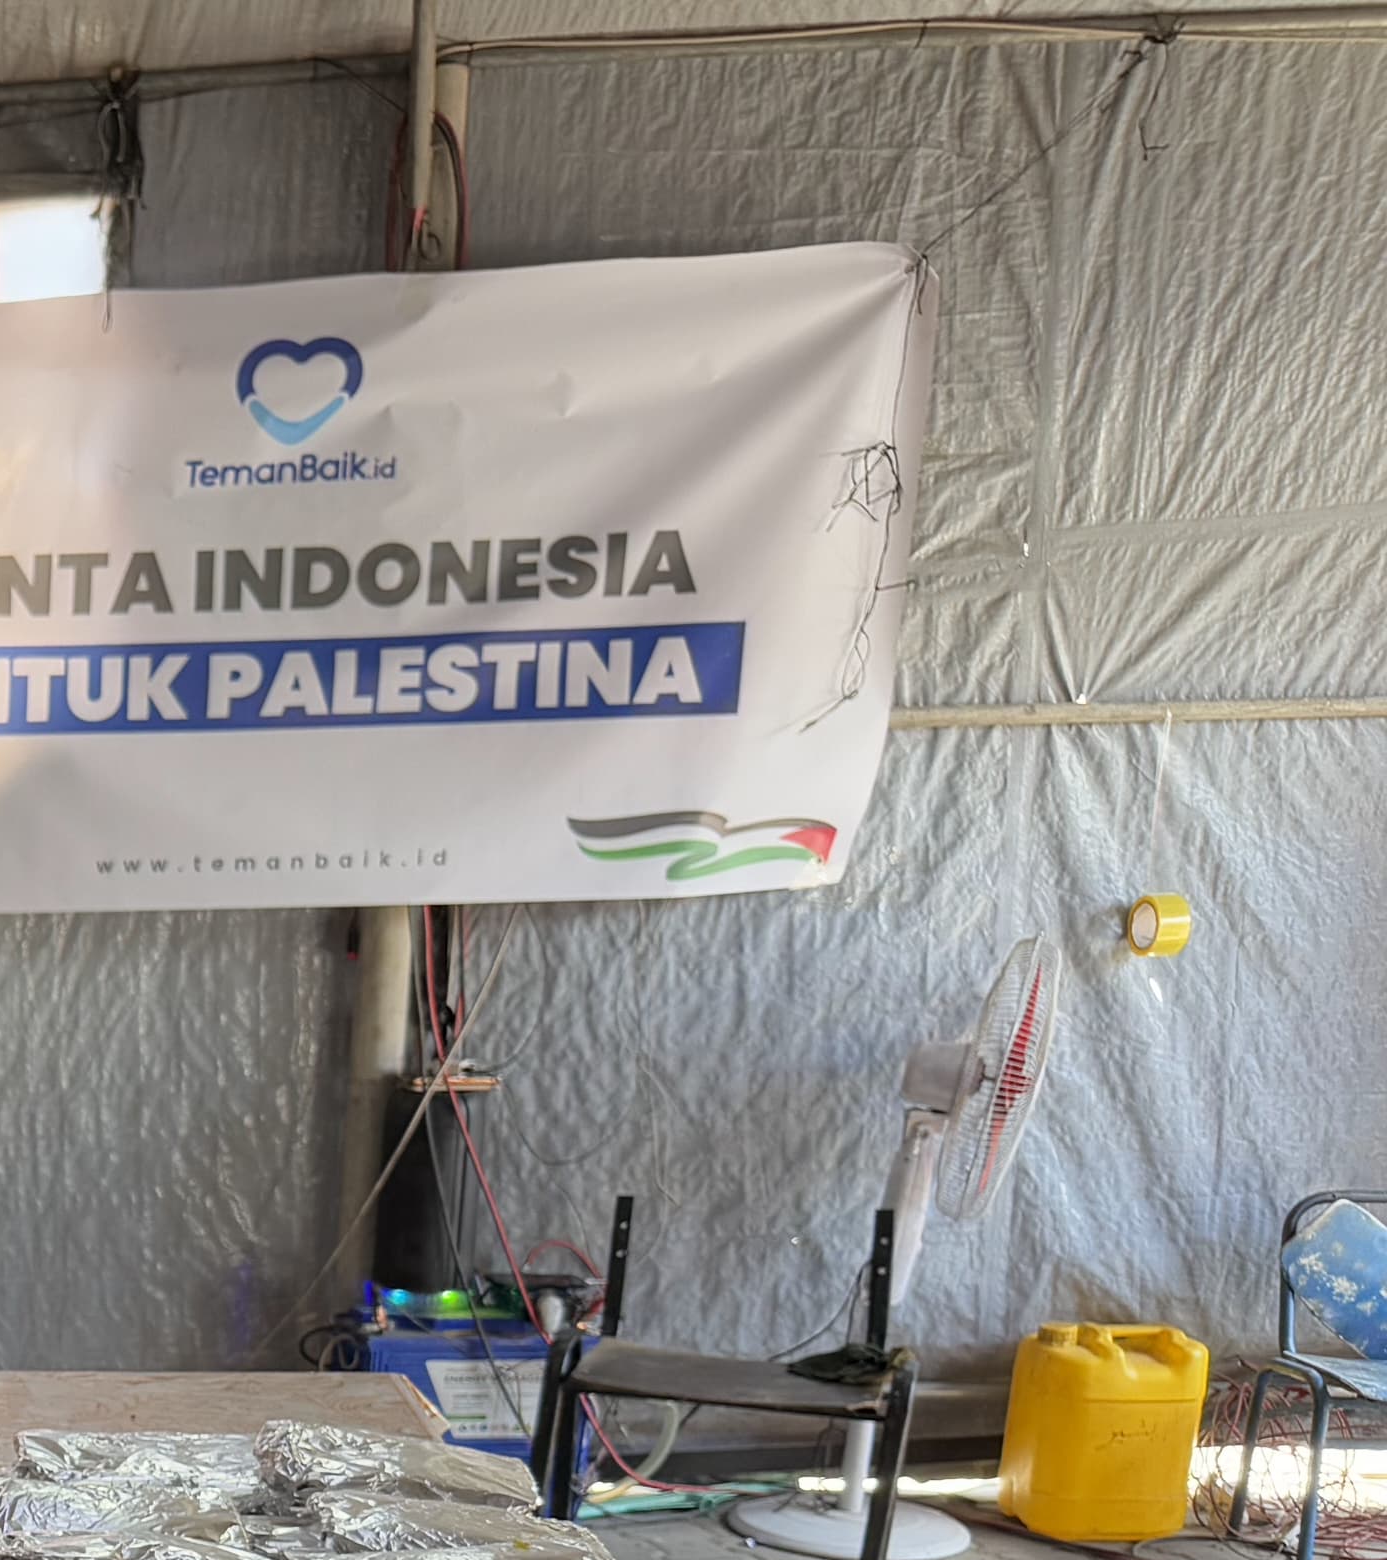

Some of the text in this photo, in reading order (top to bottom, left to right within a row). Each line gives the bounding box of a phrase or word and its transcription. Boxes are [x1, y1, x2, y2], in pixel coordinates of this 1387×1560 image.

[185, 453, 396, 489] TemanBaik.id
[195, 529, 696, 613] INDONESIA
[208, 635, 702, 720] PALESTINA
[96, 847, 449, 875] www.temanbaik.id
